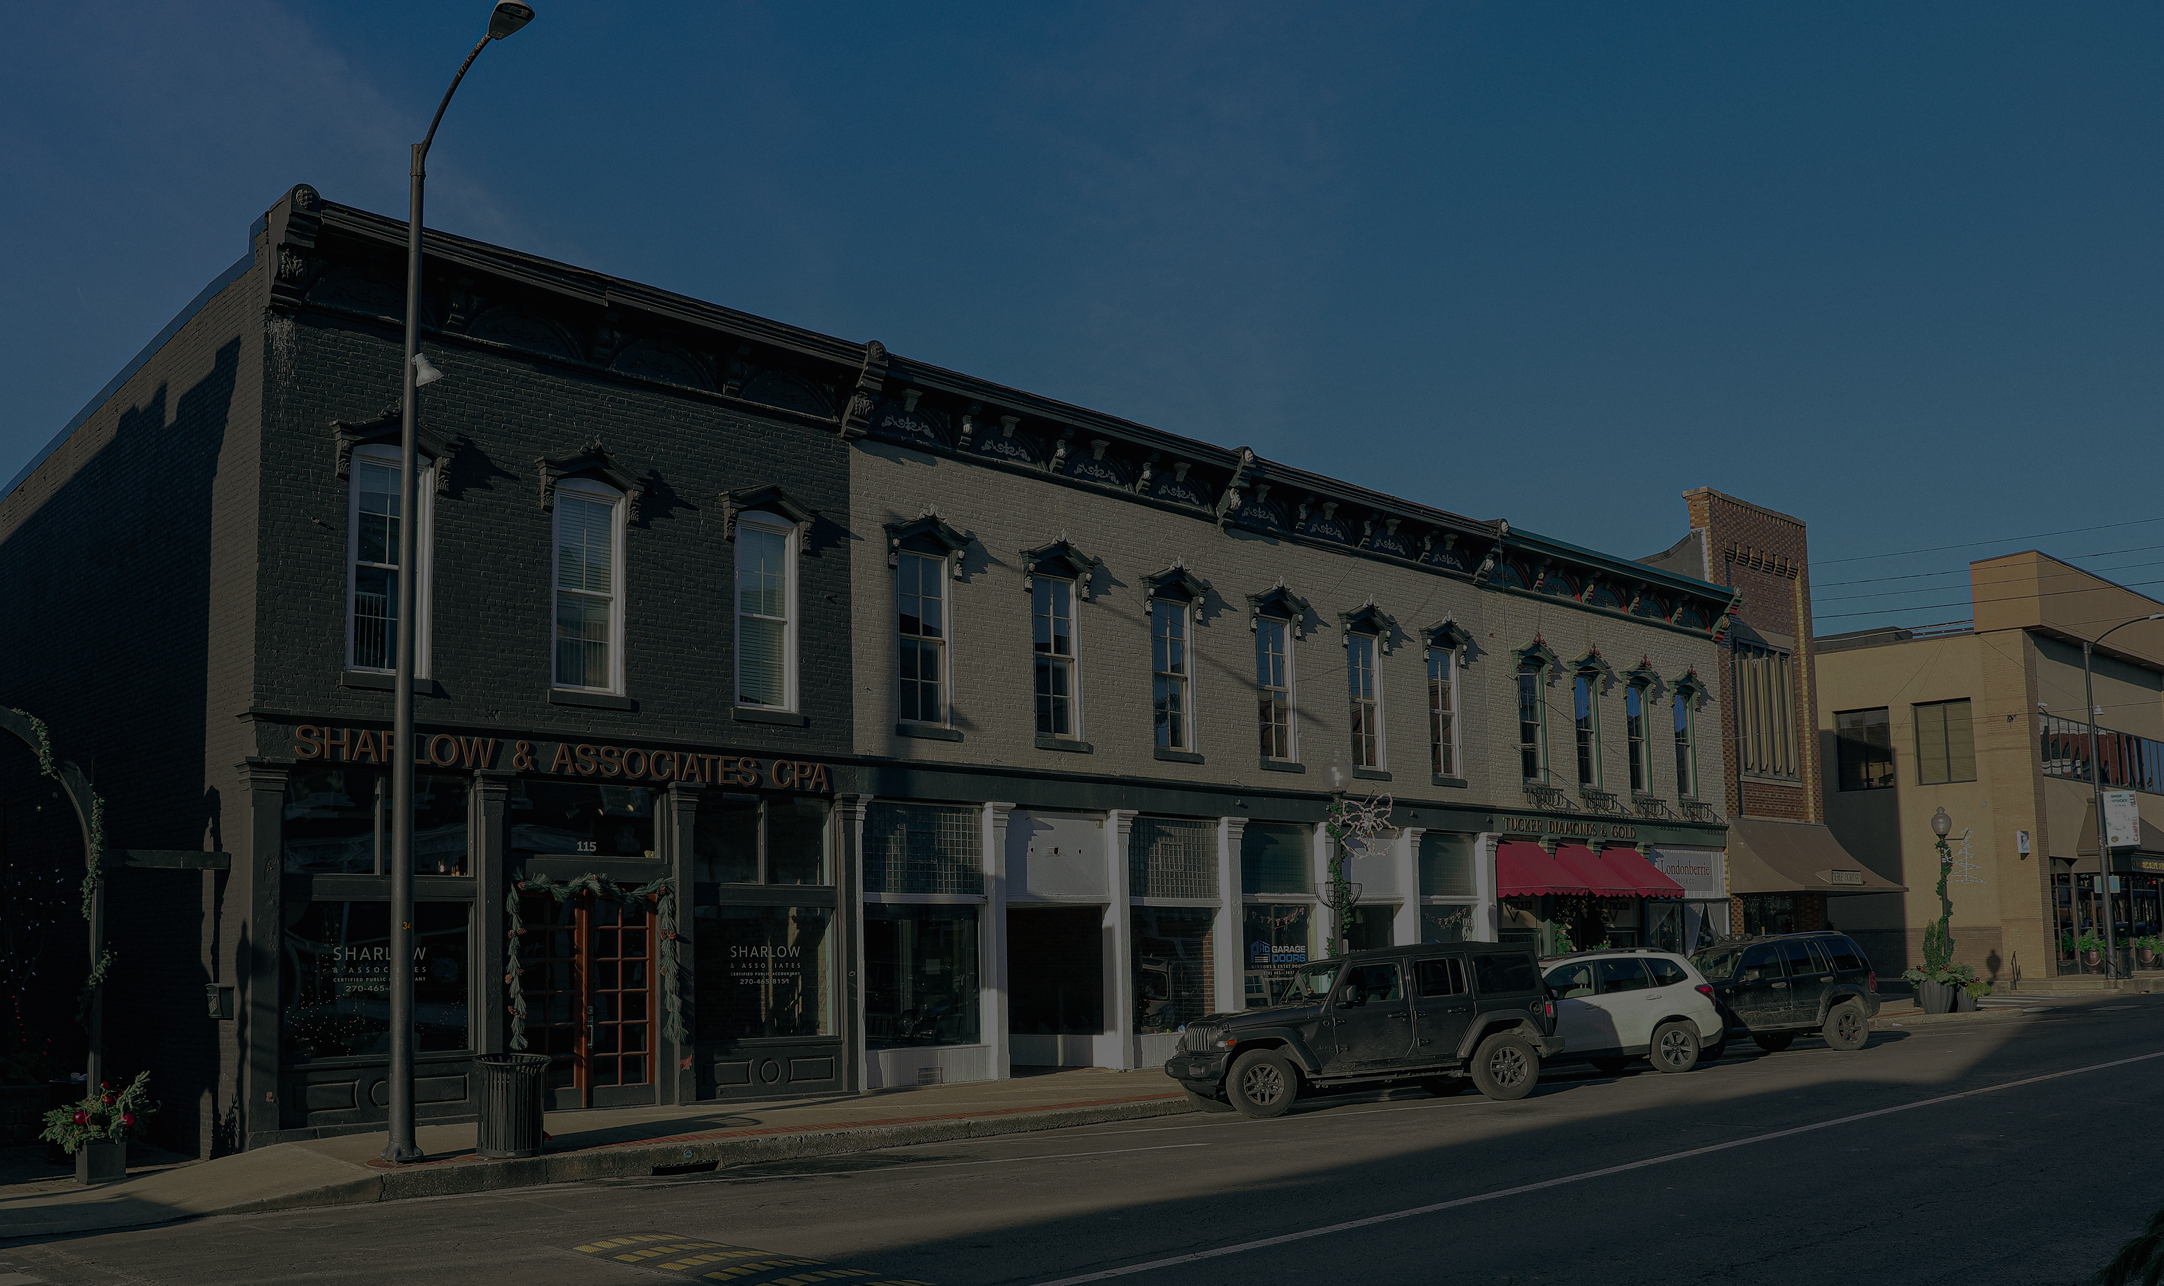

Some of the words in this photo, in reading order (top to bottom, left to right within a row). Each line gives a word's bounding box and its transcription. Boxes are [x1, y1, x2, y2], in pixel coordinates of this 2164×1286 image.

[512, 739, 535, 772] &
[551, 742, 758, 787] ASSOCIATES
[771, 758, 829, 791] CPA
[2129, 793, 2139, 842] CAMPBELVILLE
[1502, 816, 1543, 833] TUCKER
[1546, 819, 1597, 837] DIAMONDS
[1600, 824, 1608, 837] &
[1610, 825, 1637, 839] GOLD
[576, 840, 597, 852] 115
[1661, 859, 1710, 876] Londonberrie
[333, 946, 427, 961] SHARLW
[730, 945, 801, 958] SHARLOW
[1271, 945, 1306, 953] GARAGE
[1271, 953, 1307, 963] DOORS
[348, 966, 427, 974] ASSOCES
[345, 985, 391, 993] 270-465-
